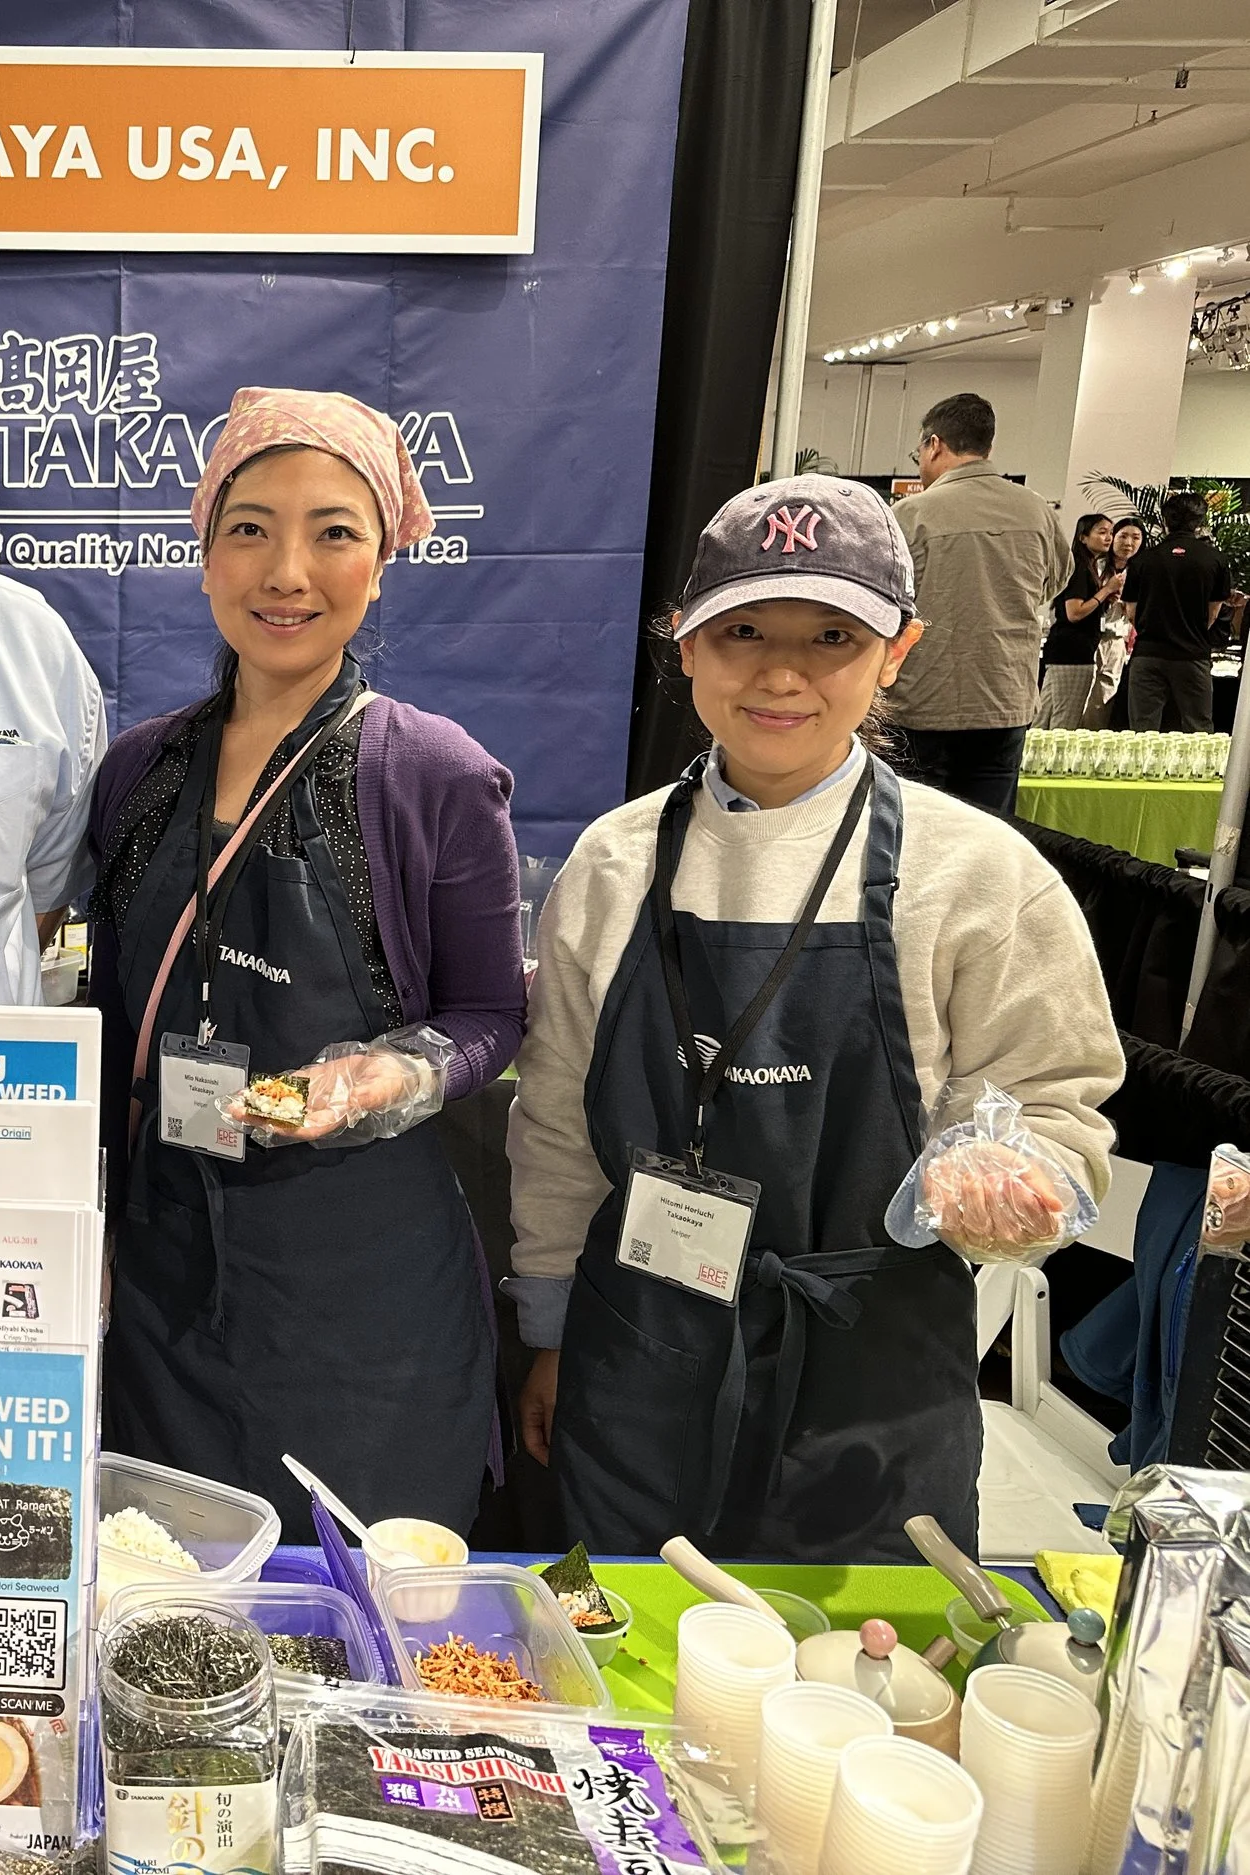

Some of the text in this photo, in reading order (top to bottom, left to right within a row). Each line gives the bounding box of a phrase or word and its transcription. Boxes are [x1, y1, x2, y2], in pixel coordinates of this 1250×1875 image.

[126, 126, 288, 190] USA,
[315, 129, 456, 184] INC.
[6, 533, 134, 577] Quality
[137, 533, 203, 568] Nor
[724, 1064, 812, 1085] AKAOKAYA
[1, 1128, 30, 1139] Origin
[667, 1210, 703, 1227] Takaokaya
[15, 1499, 51, 1511] Ramen
[29, 1525, 53, 1536] ラーメン
[15, 1582, 59, 1593] Seaweed
[0, 1698, 53, 1711] SCAN ME
[465, 1745, 536, 1769] SEAWEED
[368, 1746, 567, 1796] YAKISUSHINORI
[386, 1782, 419, 1801] 雅
[216, 1792, 233, 1848] 旬の演出
[27, 1834, 71, 1851] JAPAN
